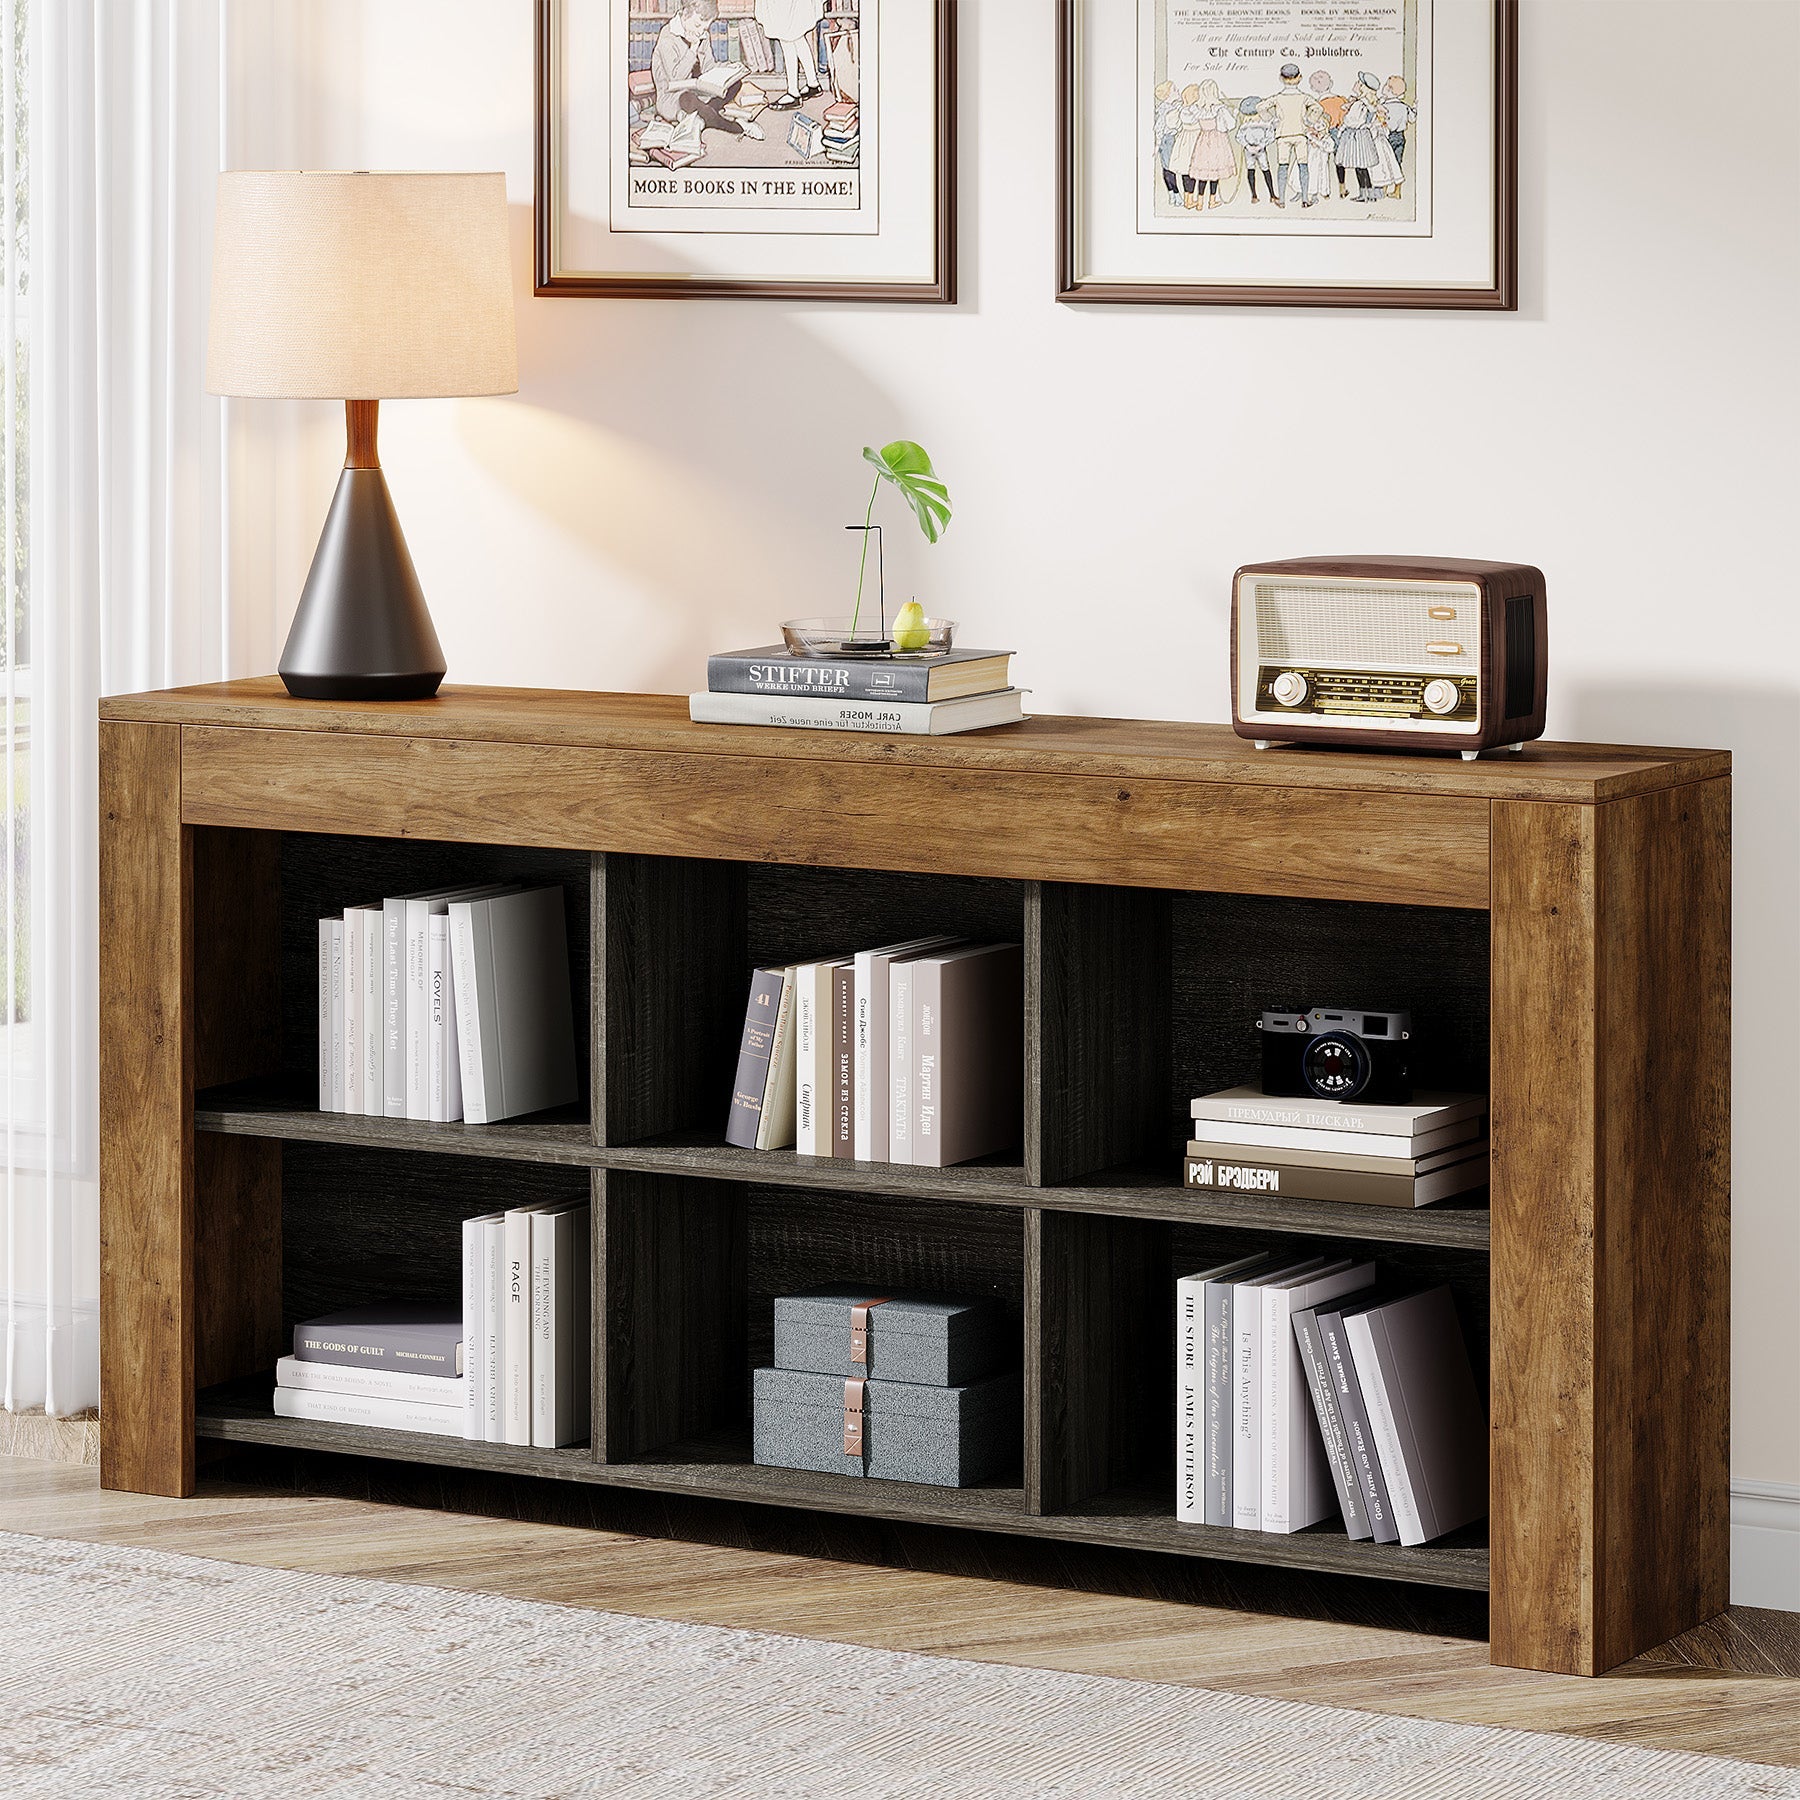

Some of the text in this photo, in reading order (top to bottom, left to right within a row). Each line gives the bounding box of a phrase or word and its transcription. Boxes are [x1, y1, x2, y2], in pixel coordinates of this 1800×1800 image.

[1192, 34, 1205, 42] All
[1226, 34, 1269, 42] Illustrated
[1273, 34, 1289, 42] and
[1293, 33, 1311, 42] Sold
[1328, 34, 1346, 42] Low
[1351, 34, 1378, 42] Prices.
[1208, 47, 1228, 57] The
[1235, 47, 1274, 58] Century
[1305, 46, 1362, 58] Publishers.
[1183, 63, 1249, 71] For Sale Here.
[634, 180, 853, 195] MORE BOOKS IN THE HOME!
[749, 665, 850, 687] STIFTER
[756, 682, 845, 694] WERKE UND BRIEFE
[388, 917, 398, 1050] The Last Time They Met
[433, 971, 442, 1026] KOVELS'
[755, 994, 770, 1007] 41
[737, 1091, 759, 1103] George
[800, 1083, 812, 1130] Спартак
[896, 1076, 906, 1140] ТРАКТАТЫ
[919, 1055, 934, 1135] Мартин Иден
[1228, 1106, 1364, 1129] ПРЕМУДРЫЙ ПИСКАРЬ
[1189, 1160, 1280, 1192] РЭЙ БРЭДБЕРИ
[511, 1261, 520, 1303] RAGE
[1185, 1295, 1194, 1369] THE STORE
[1303, 1327, 1313, 1354] Cochran
[304, 1340, 385, 1356] THE GODS OF GUILT
[395, 1351, 446, 1361] MICHAEL CONNELLY
[1316, 1362, 1326, 1380] Print
[1329, 1332, 1349, 1393] MICHAEL SAVAGE
[1240, 1332, 1251, 1439] Is This Anything?
[1322, 1389, 1332, 1402] Age
[1209, 1325, 1220, 1478] The Origins of Our Discontents
[1314, 1388, 1325, 1415] Literary
[1326, 1404, 1335, 1415] the
[1185, 1385, 1194, 1510] JAMES PATTERSON
[1325, 1436, 1337, 1464] Twilight
[1331, 1423, 1344, 1451] Thought
[1340, 1460, 1353, 1487] Figures
[1352, 1421, 1383, 1520] GOD, FAITH, AND REASON
[1348, 1499, 1356, 1518] Terry
